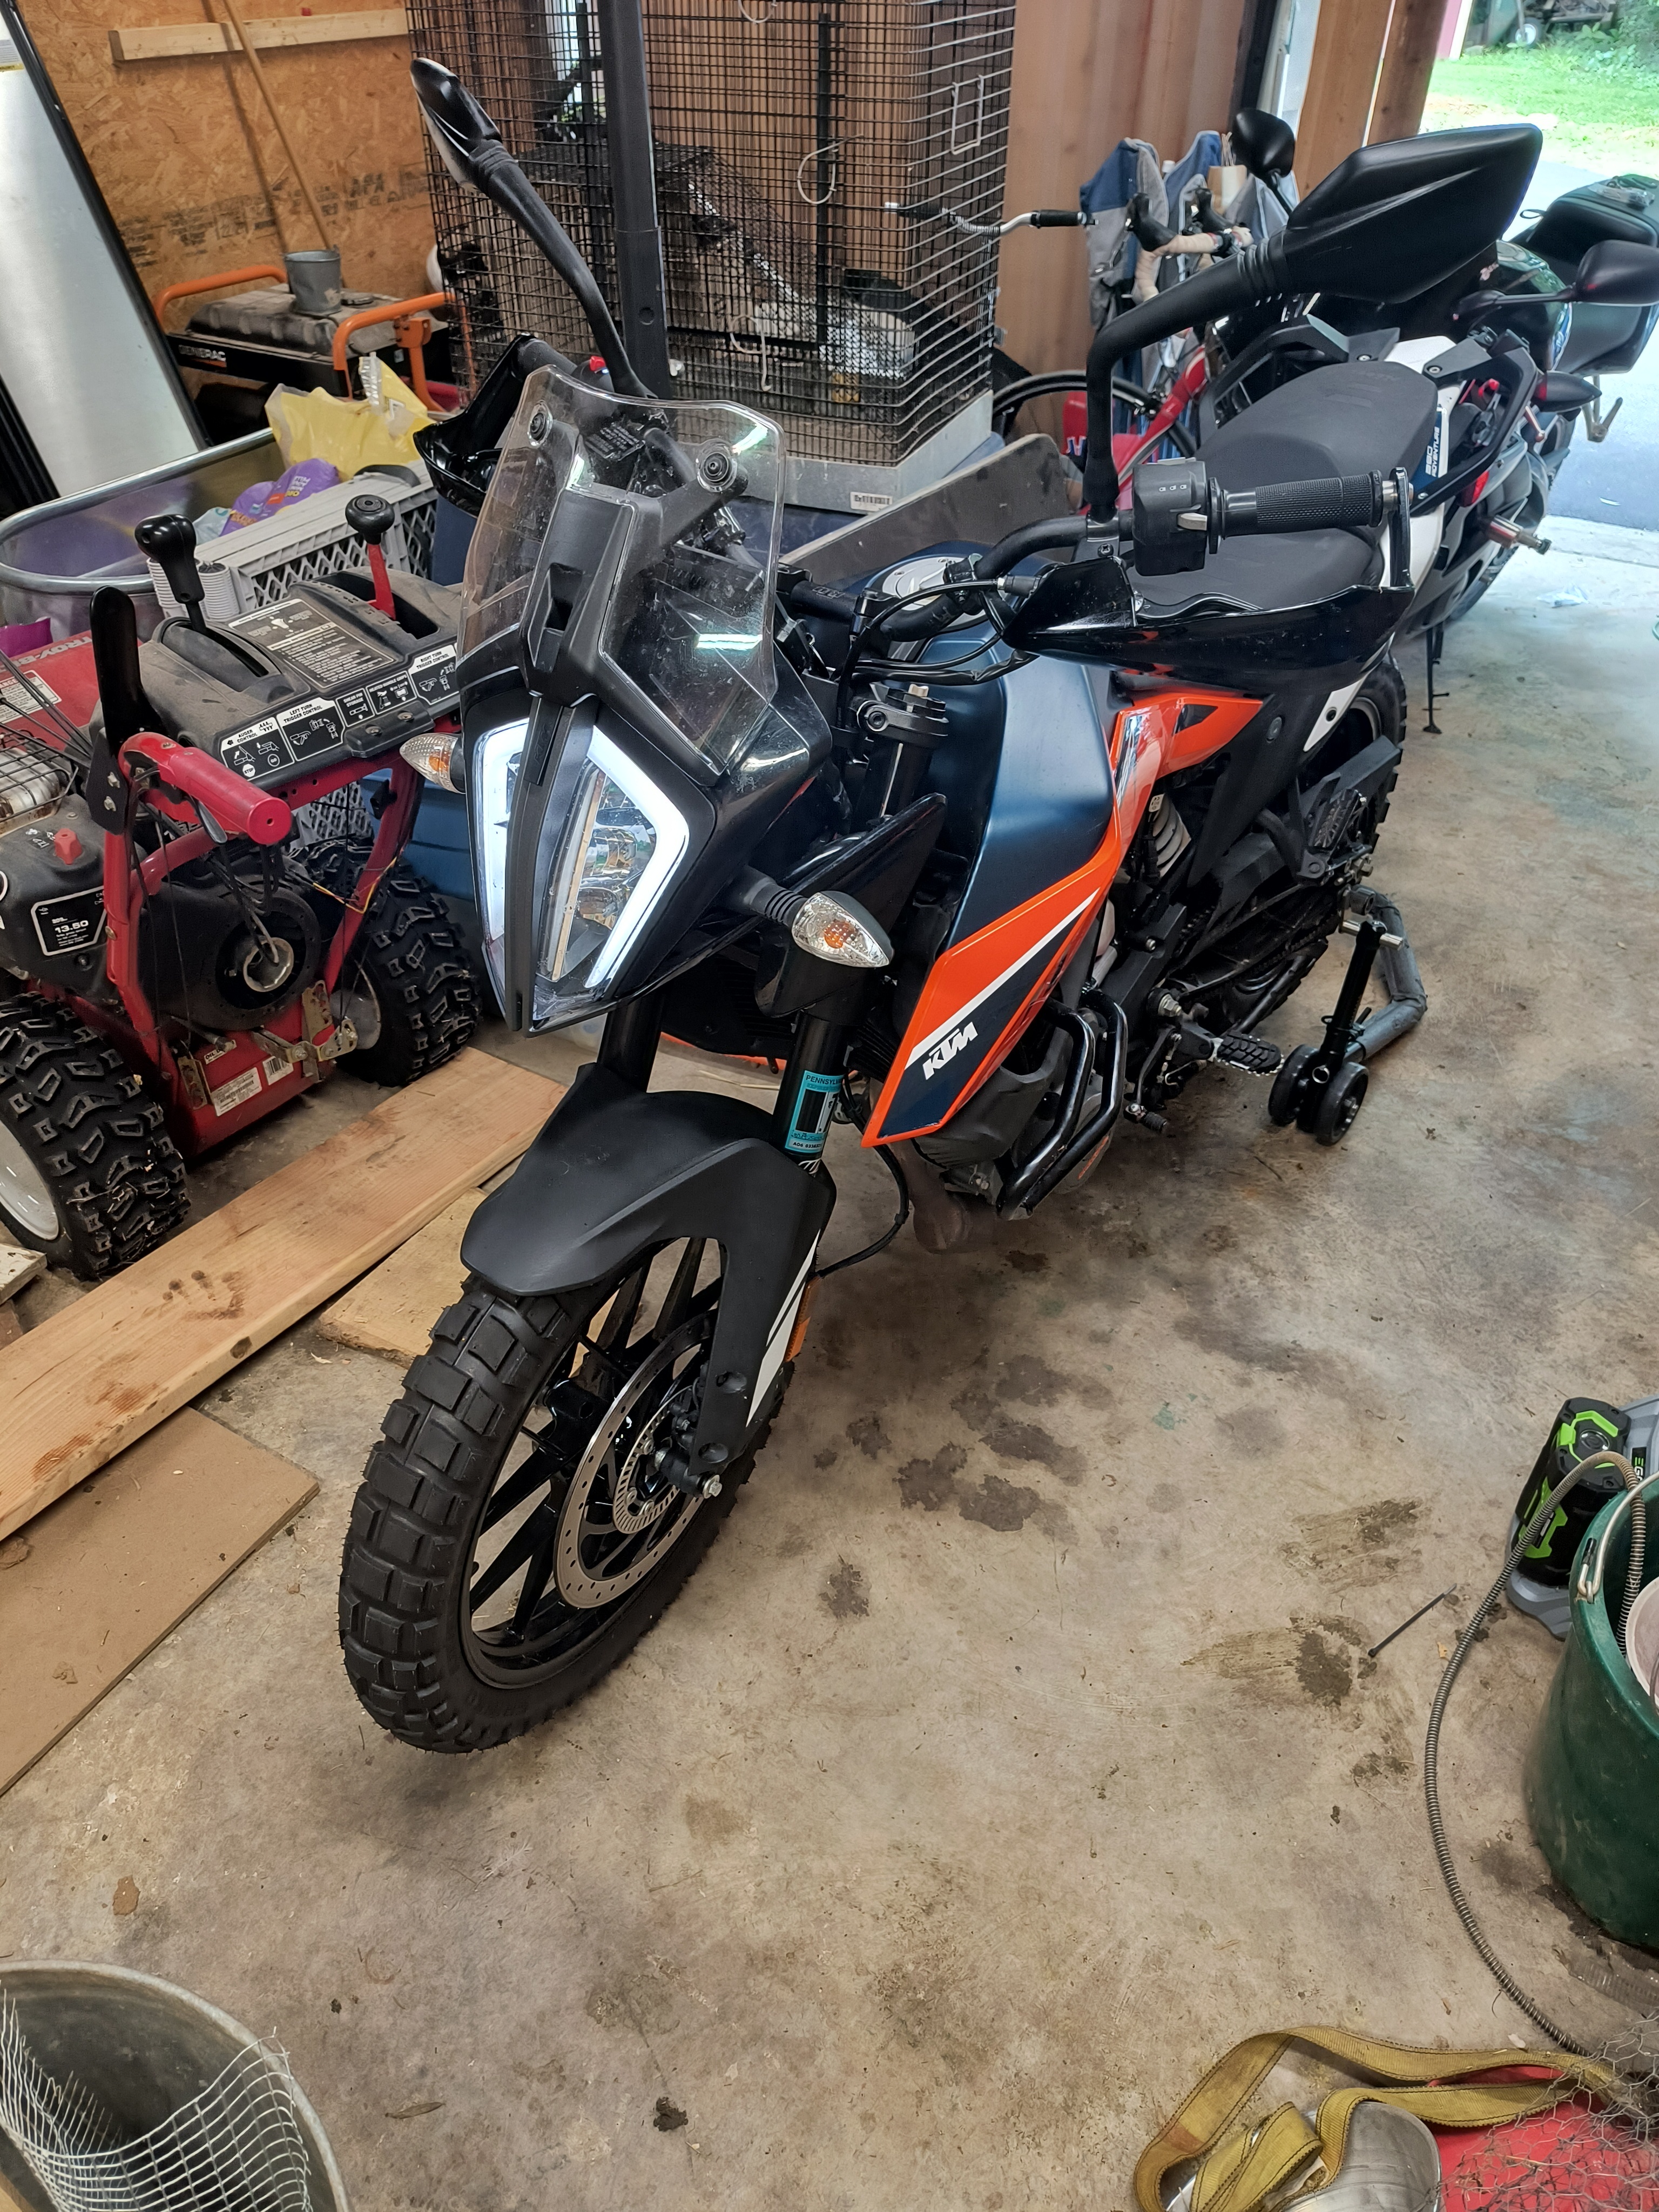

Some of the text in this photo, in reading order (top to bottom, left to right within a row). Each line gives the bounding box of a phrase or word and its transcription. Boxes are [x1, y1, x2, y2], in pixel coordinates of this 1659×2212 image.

[1431, 426, 1440, 477] ADVENTURE
[416, 653, 449, 669] TRIGGER CONTROL
[346, 697, 364, 707] STORAGE
[284, 705, 322, 723] TRIGGER CONTROL
[237, 729, 258, 743] AUGER CONTROL
[55, 920, 89, 933] 13.50
[922, 1021, 979, 1080] KTM
